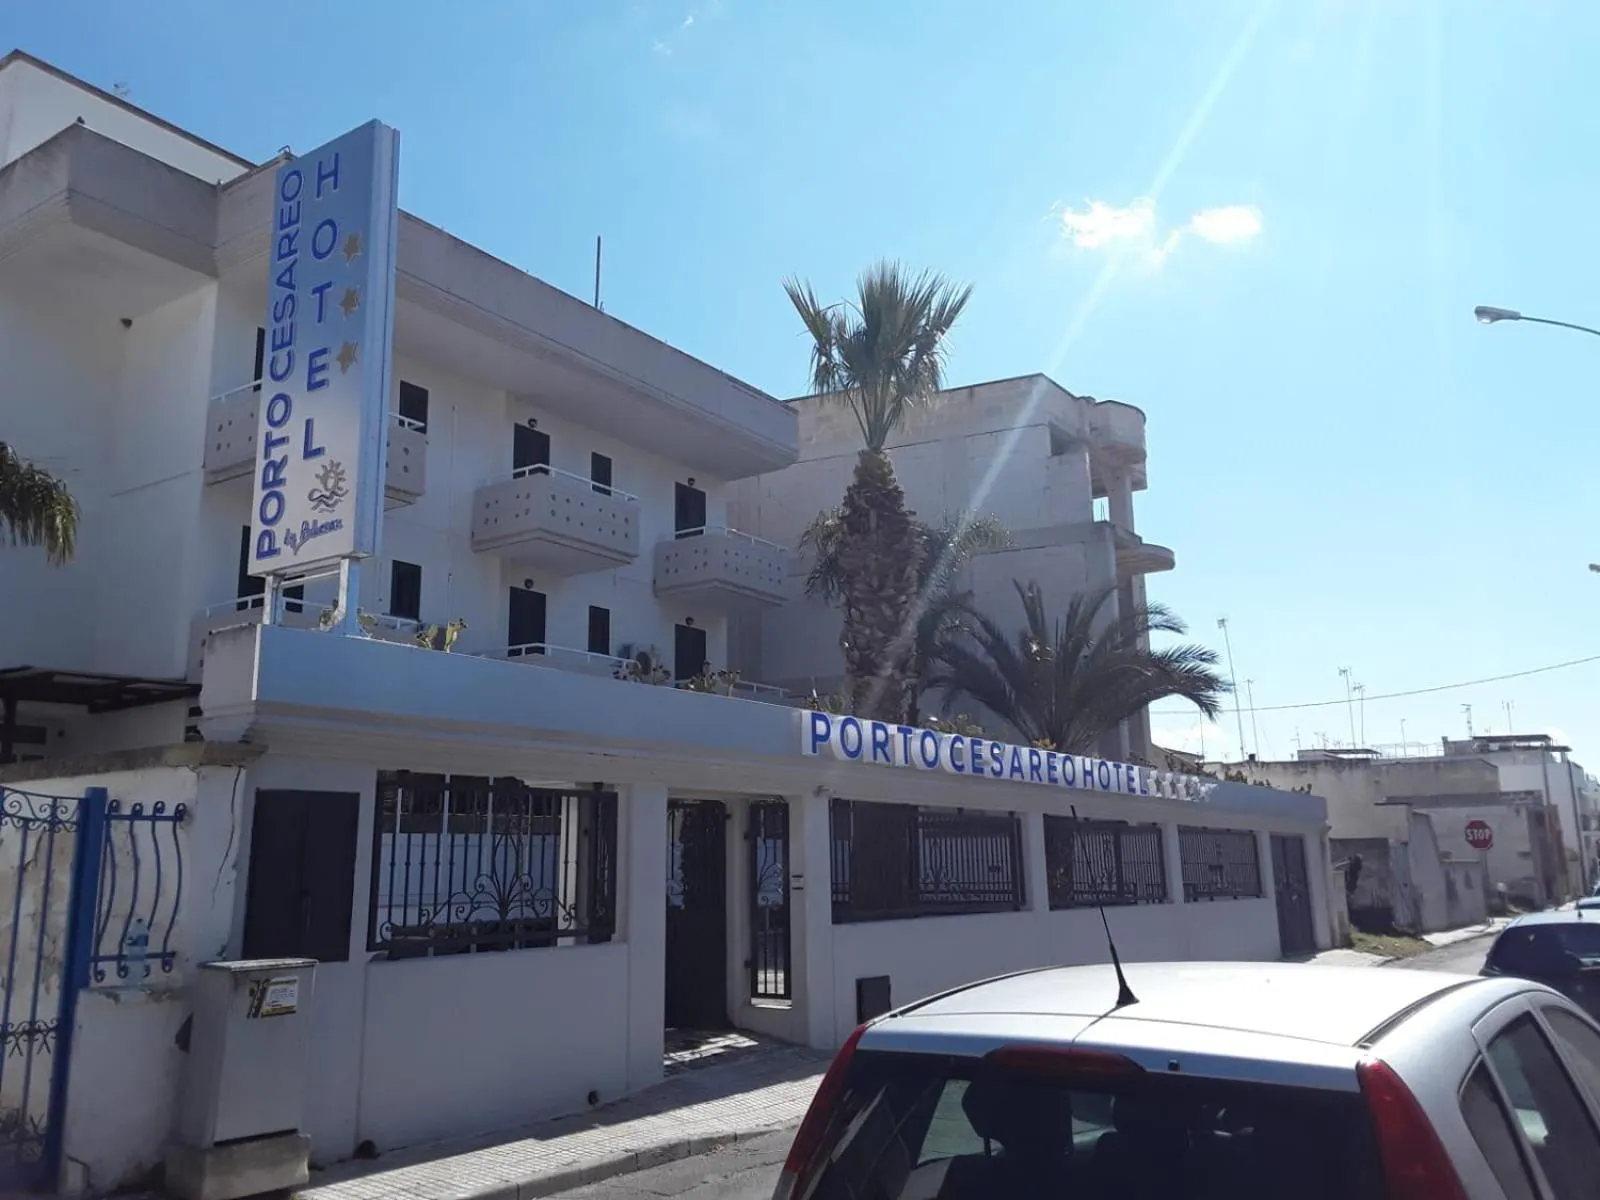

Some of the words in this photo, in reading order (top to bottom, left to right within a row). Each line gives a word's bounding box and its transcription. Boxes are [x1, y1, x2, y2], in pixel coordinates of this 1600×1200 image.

[270, 169, 304, 383] CESAREO
[303, 152, 340, 460] HOTEL
[256, 393, 292, 560] PORTO
[810, 711, 939, 769] PORTO
[949, 734, 1077, 788] CESAREO
[1082, 757, 1148, 796] HOTEL
[1465, 828, 1490, 841] STOP
